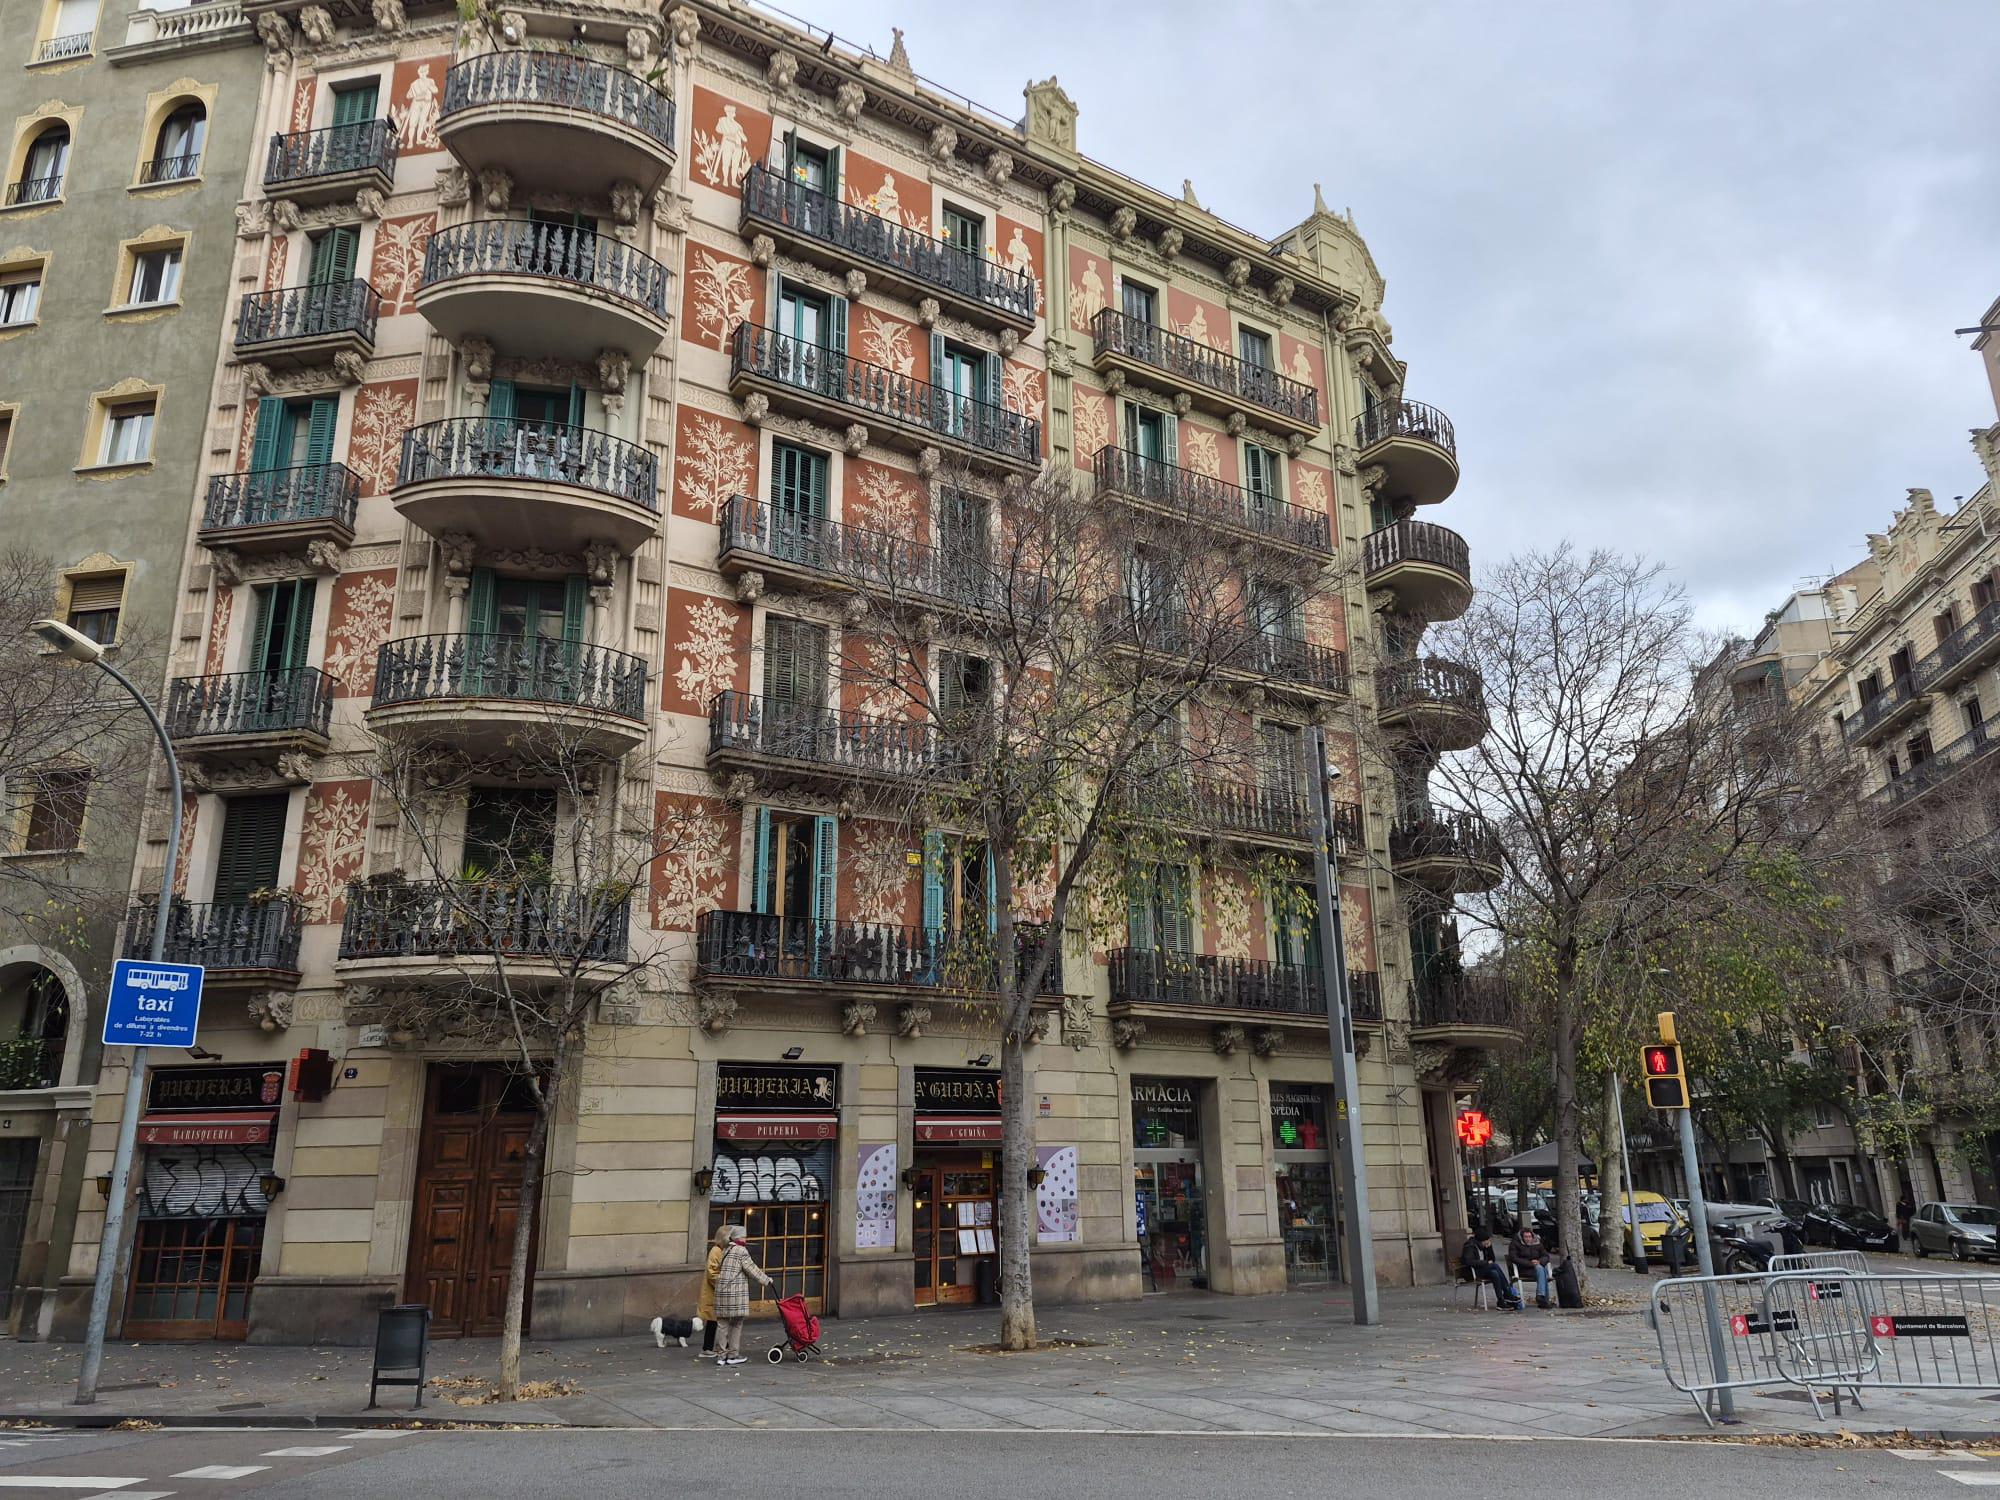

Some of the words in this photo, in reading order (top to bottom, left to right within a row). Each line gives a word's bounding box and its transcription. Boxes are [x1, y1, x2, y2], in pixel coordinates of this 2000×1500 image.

[138, 995, 174, 1012] taxi
[134, 1015, 170, 1023] Laborables
[126, 1022, 146, 1030] dilluns
[157, 1024, 188, 1032] divendres
[717, 1076, 813, 1098] PULPERIA
[1131, 1083, 1192, 1101] RMÀCIA
[173, 1129, 233, 1141] MARISQUERIA
[757, 1126, 799, 1136] PULPERIA
